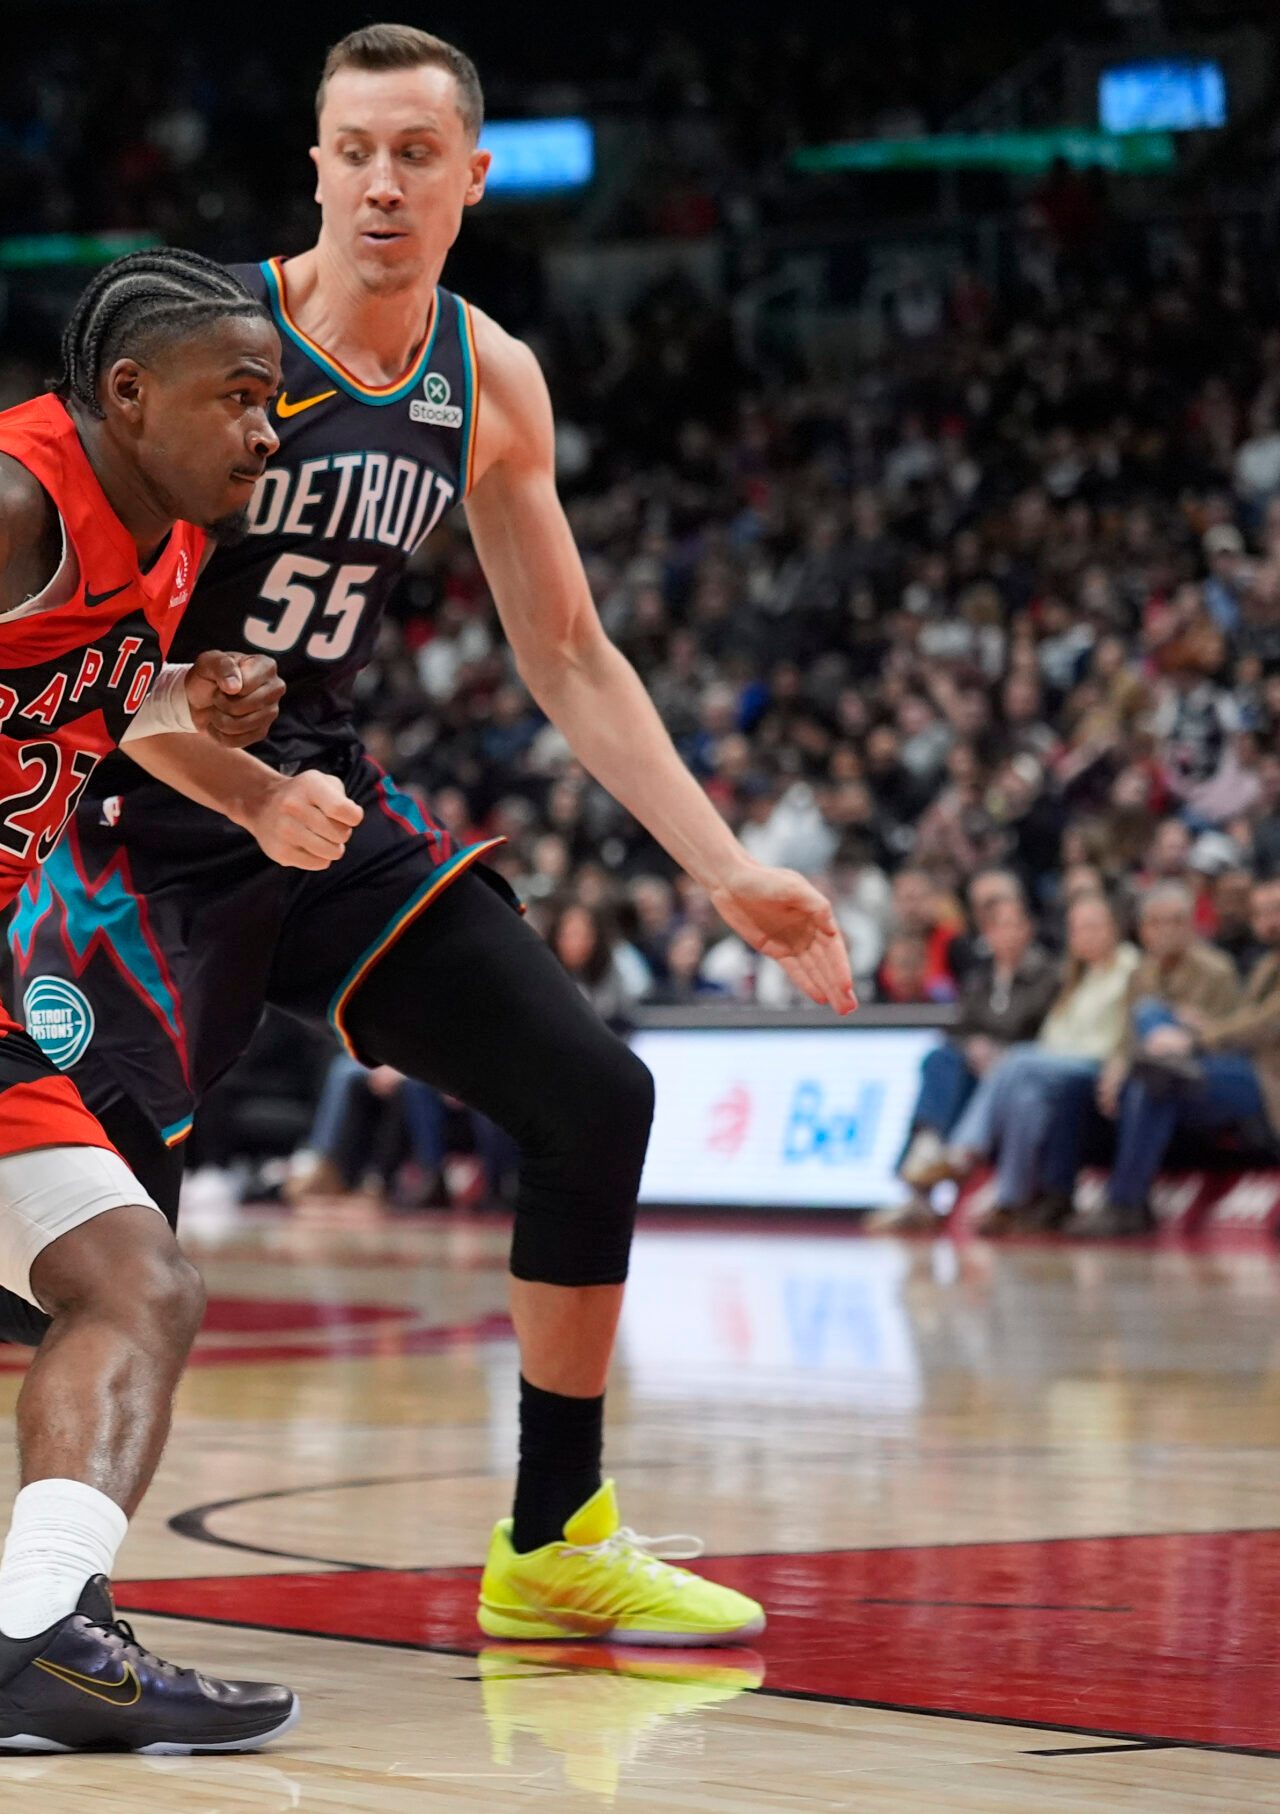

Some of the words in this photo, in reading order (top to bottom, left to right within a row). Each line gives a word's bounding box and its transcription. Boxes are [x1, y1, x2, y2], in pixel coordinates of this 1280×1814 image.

[412, 403, 460, 425] StockX
[247, 452, 455, 556] DETROIT
[243, 553, 377, 661] 55
